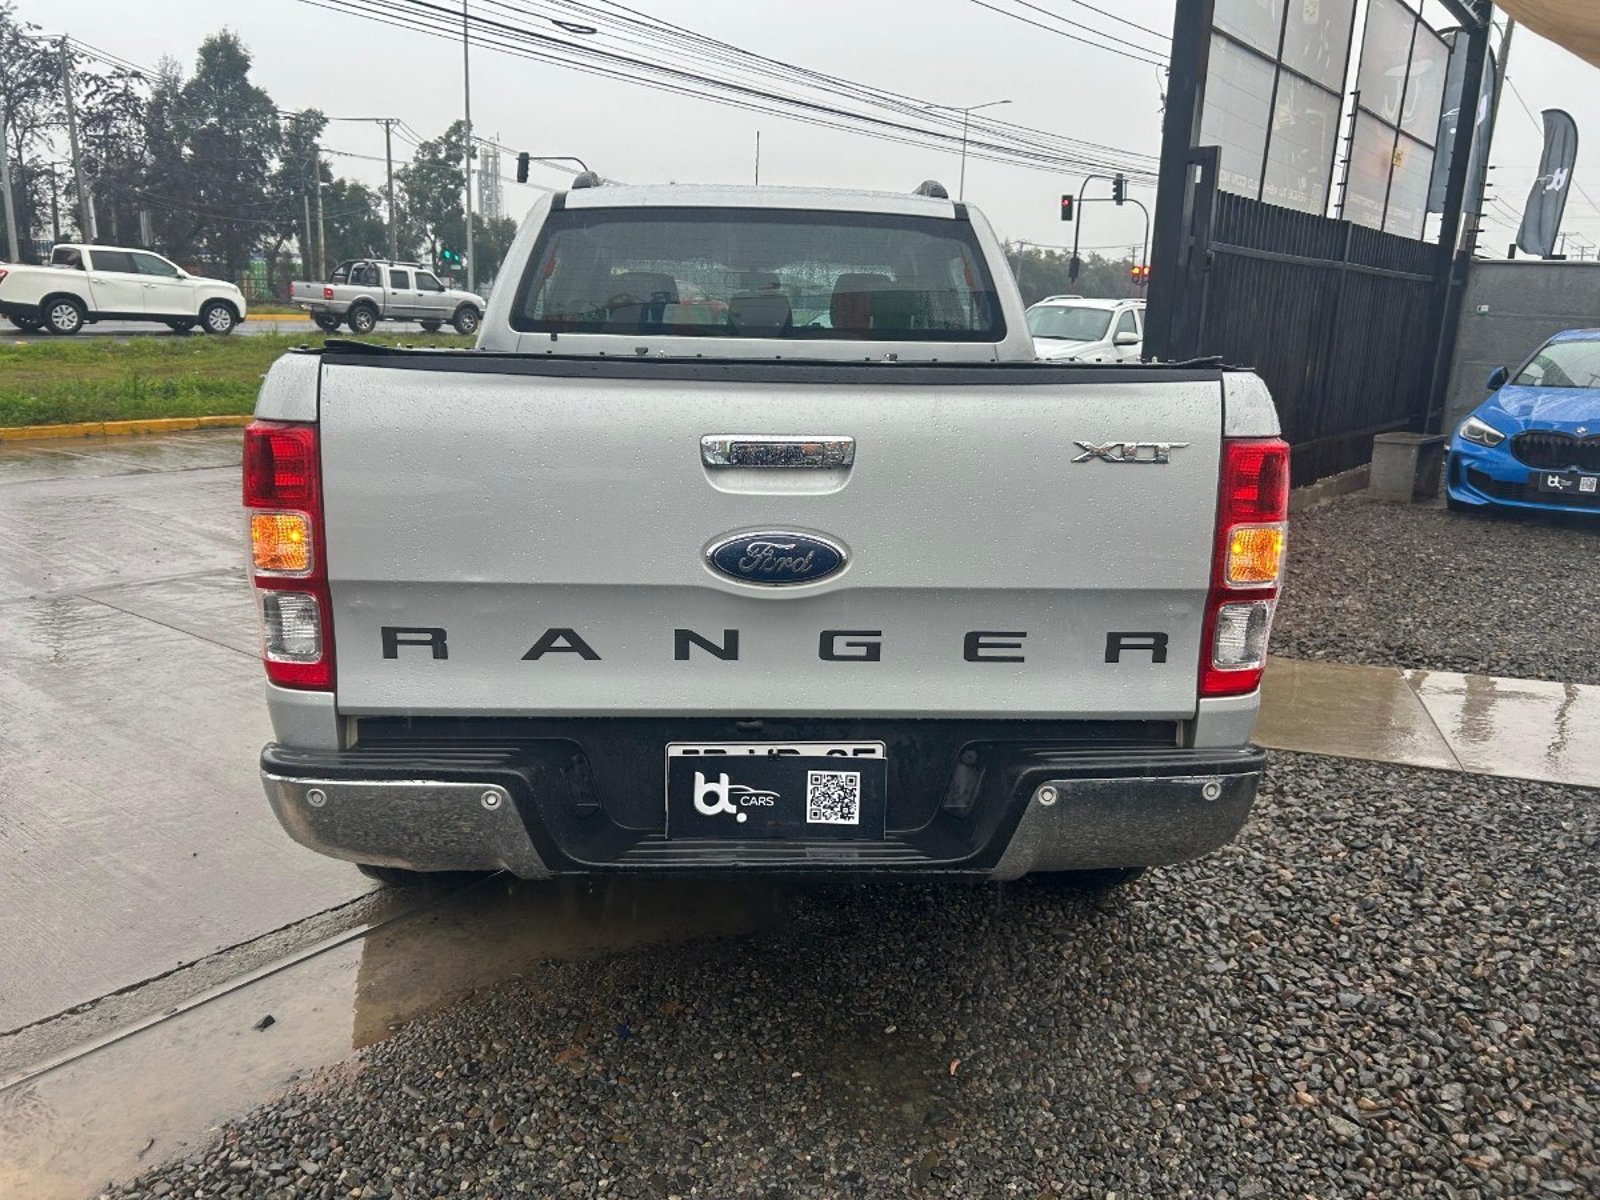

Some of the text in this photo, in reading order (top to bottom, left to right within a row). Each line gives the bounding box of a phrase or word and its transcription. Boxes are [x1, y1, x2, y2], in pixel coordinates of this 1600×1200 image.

[1071, 440, 1190, 464] XLT
[738, 541, 815, 573] Ford
[381, 626, 1169, 663] RANGER
[740, 796, 774, 806] CARS
